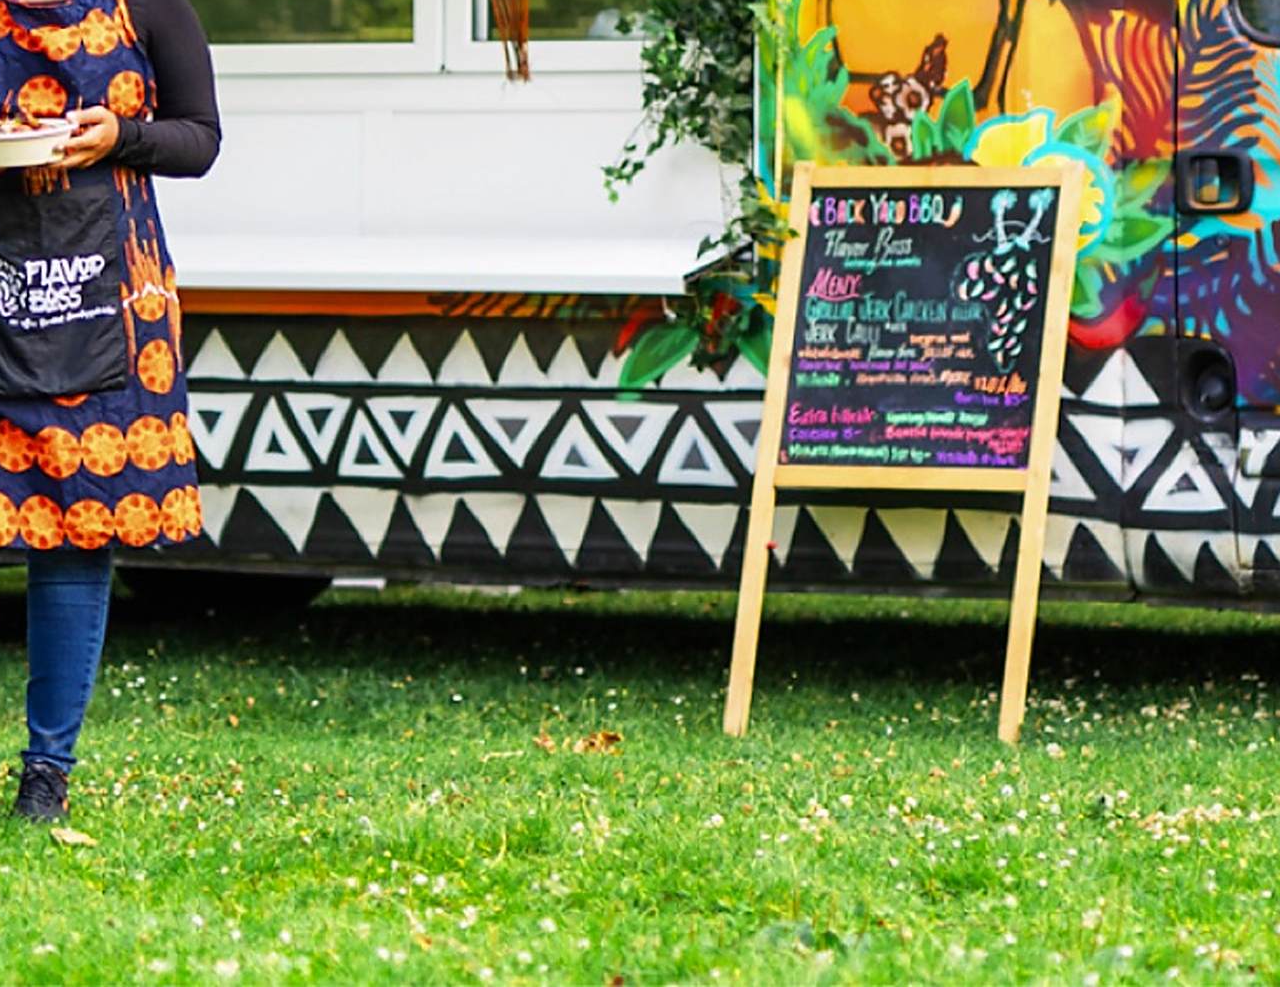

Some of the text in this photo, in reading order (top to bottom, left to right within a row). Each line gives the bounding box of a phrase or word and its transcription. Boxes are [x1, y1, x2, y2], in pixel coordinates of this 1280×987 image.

[824, 196, 865, 225] BACK
[909, 193, 944, 224] BBQ
[28, 283, 83, 313] BOSS
